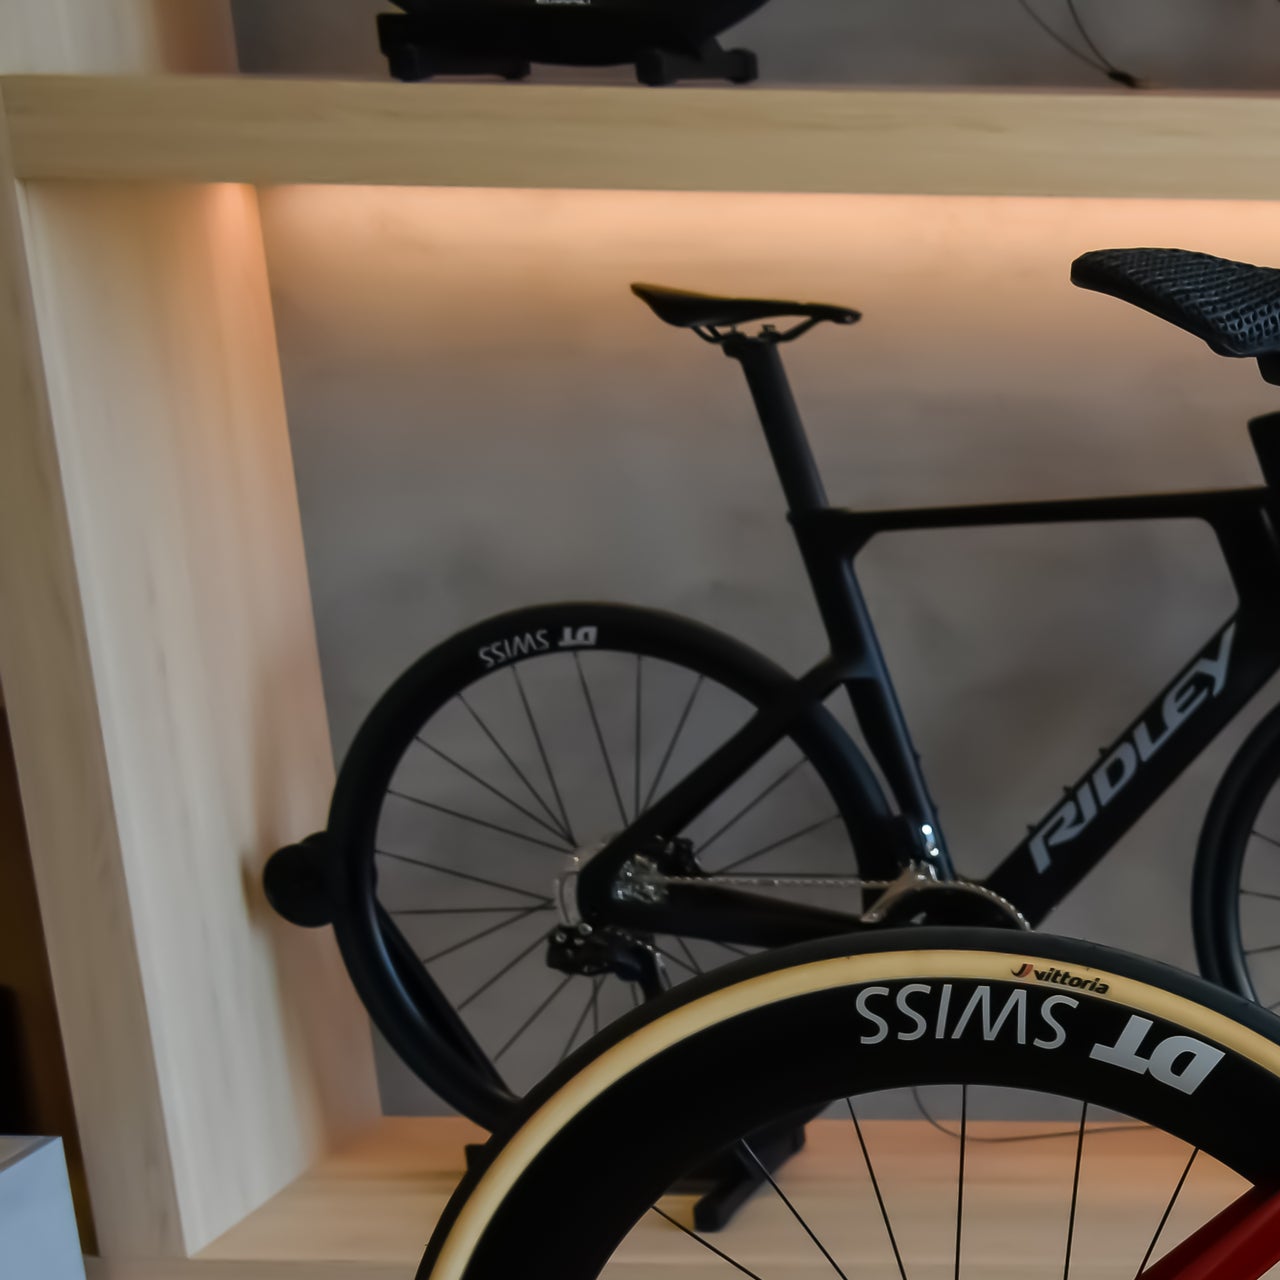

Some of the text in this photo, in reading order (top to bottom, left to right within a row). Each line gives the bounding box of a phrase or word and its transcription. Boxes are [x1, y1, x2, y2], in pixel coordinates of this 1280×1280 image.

[478, 626, 598, 669] DT SWISS
[1028, 620, 1236, 875] RIDLEY
[1032, 966, 1111, 996] vittoria
[855, 983, 1226, 1096] DT SWISS
